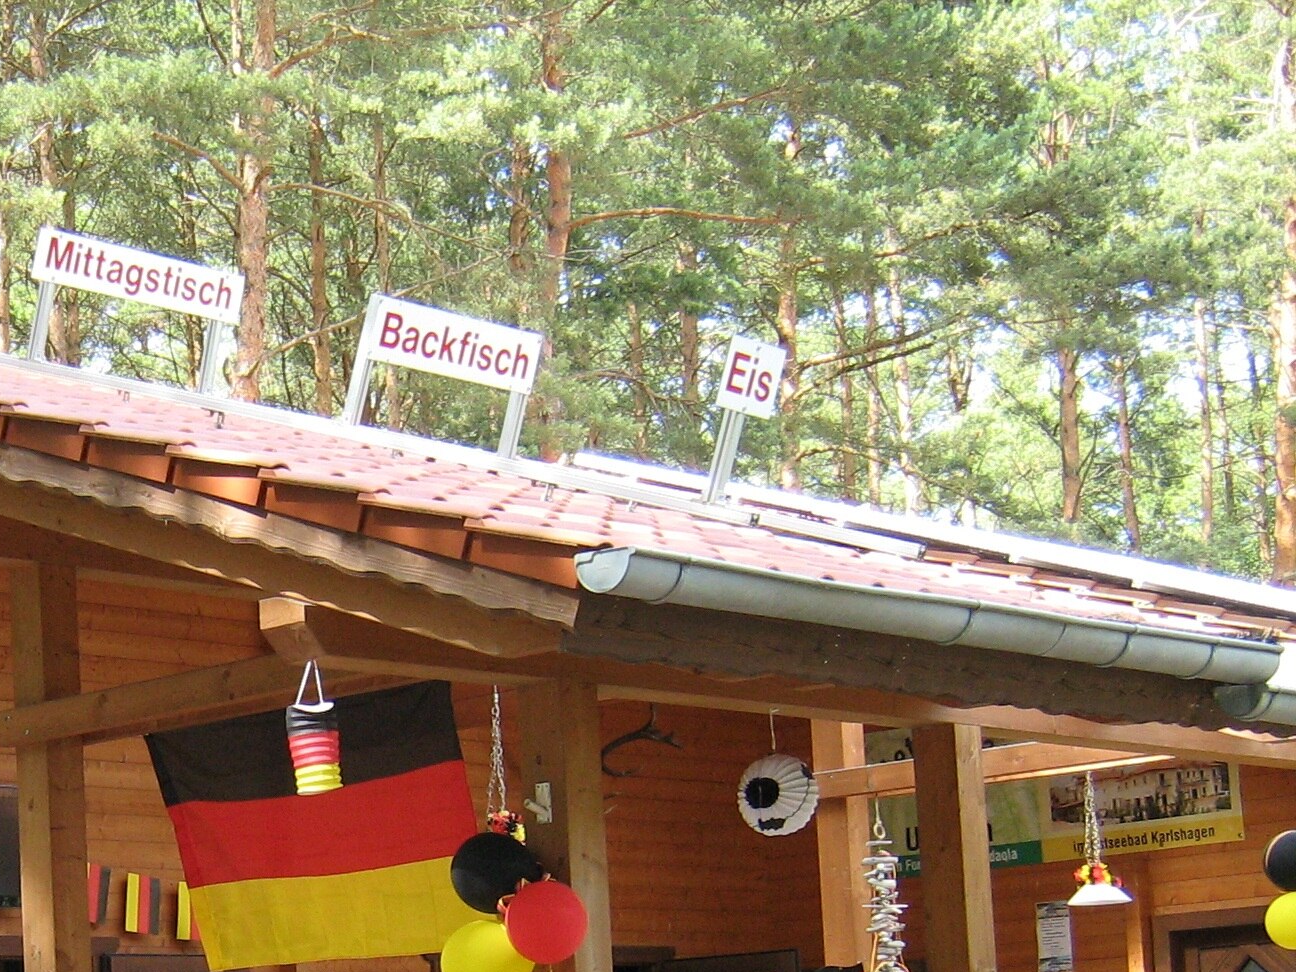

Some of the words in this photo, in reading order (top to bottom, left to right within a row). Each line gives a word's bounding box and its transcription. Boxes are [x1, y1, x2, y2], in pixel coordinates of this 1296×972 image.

[45, 237, 233, 310] Mittagstisch
[379, 312, 530, 380] Backfisch
[725, 352, 773, 403] Eis
[1151, 826, 1215, 848] Karlshagen
